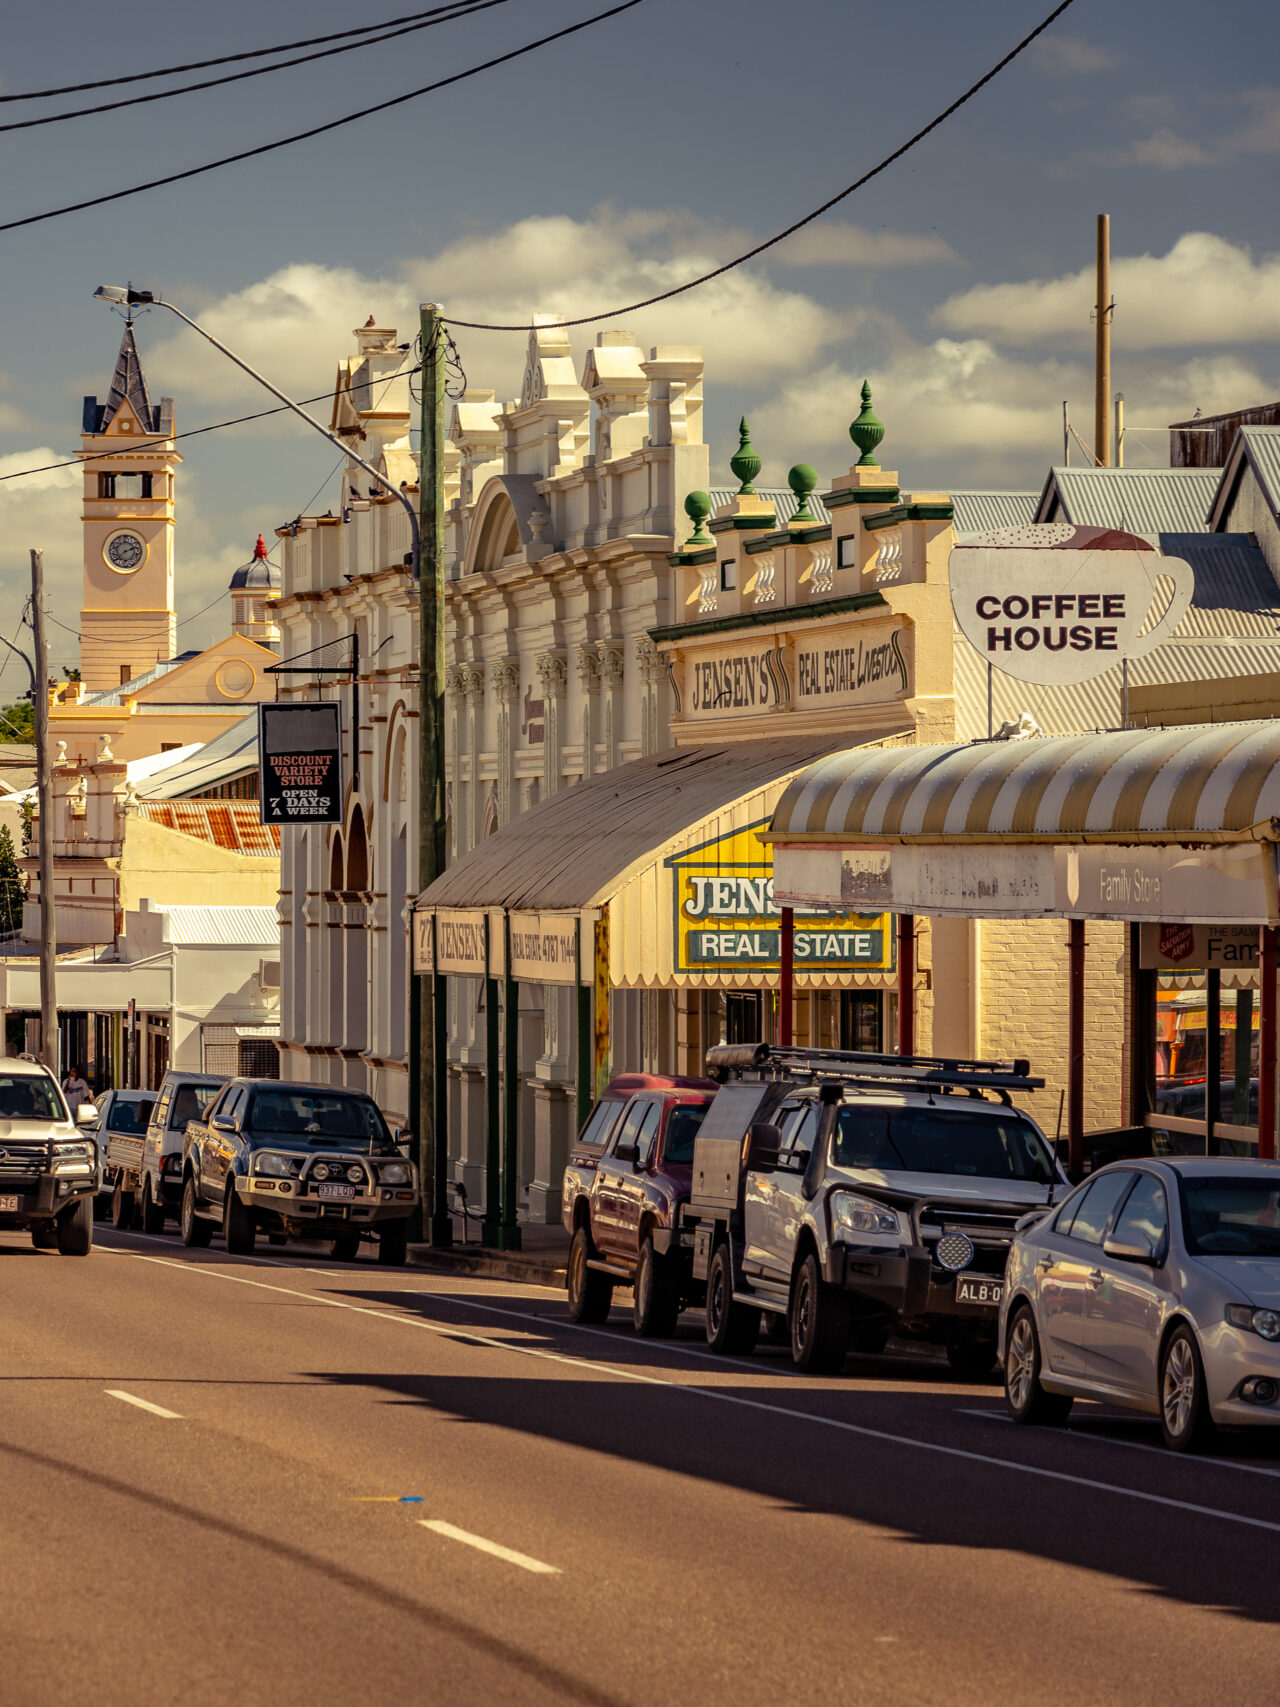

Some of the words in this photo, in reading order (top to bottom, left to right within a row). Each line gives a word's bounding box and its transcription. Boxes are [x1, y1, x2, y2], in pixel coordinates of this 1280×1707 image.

[976, 594, 1126, 620] COFFEE
[987, 625, 1118, 651] HOUSE
[692, 654, 769, 710] JENSEN'S
[799, 651, 822, 696] REAL
[824, 648, 855, 693] ESTATE
[270, 755, 332, 766] DISCOUNT
[274, 766, 329, 776] VARIETY
[281, 776, 322, 786] STORE
[270, 798, 280, 807] 7
[286, 797, 331, 807] DAYS
[286, 807, 329, 815] WEEK
[1100, 868, 1131, 908] Family
[1133, 868, 1161, 903] Store
[420, 919, 432, 948] 77
[441, 922, 485, 960] JENSEN'S
[1160, 927, 1192, 952] SALVATION
[1166, 925, 1181, 937] THE
[1209, 928, 1228, 936] THE
[1231, 928, 1259, 936] SALVA
[542, 935, 558, 962] 4787
[701, 934, 769, 957] REAL
[778, 934, 871, 957] STATE
[1172, 942, 1190, 958] ARMY
[1207, 939, 1259, 960] Fam
